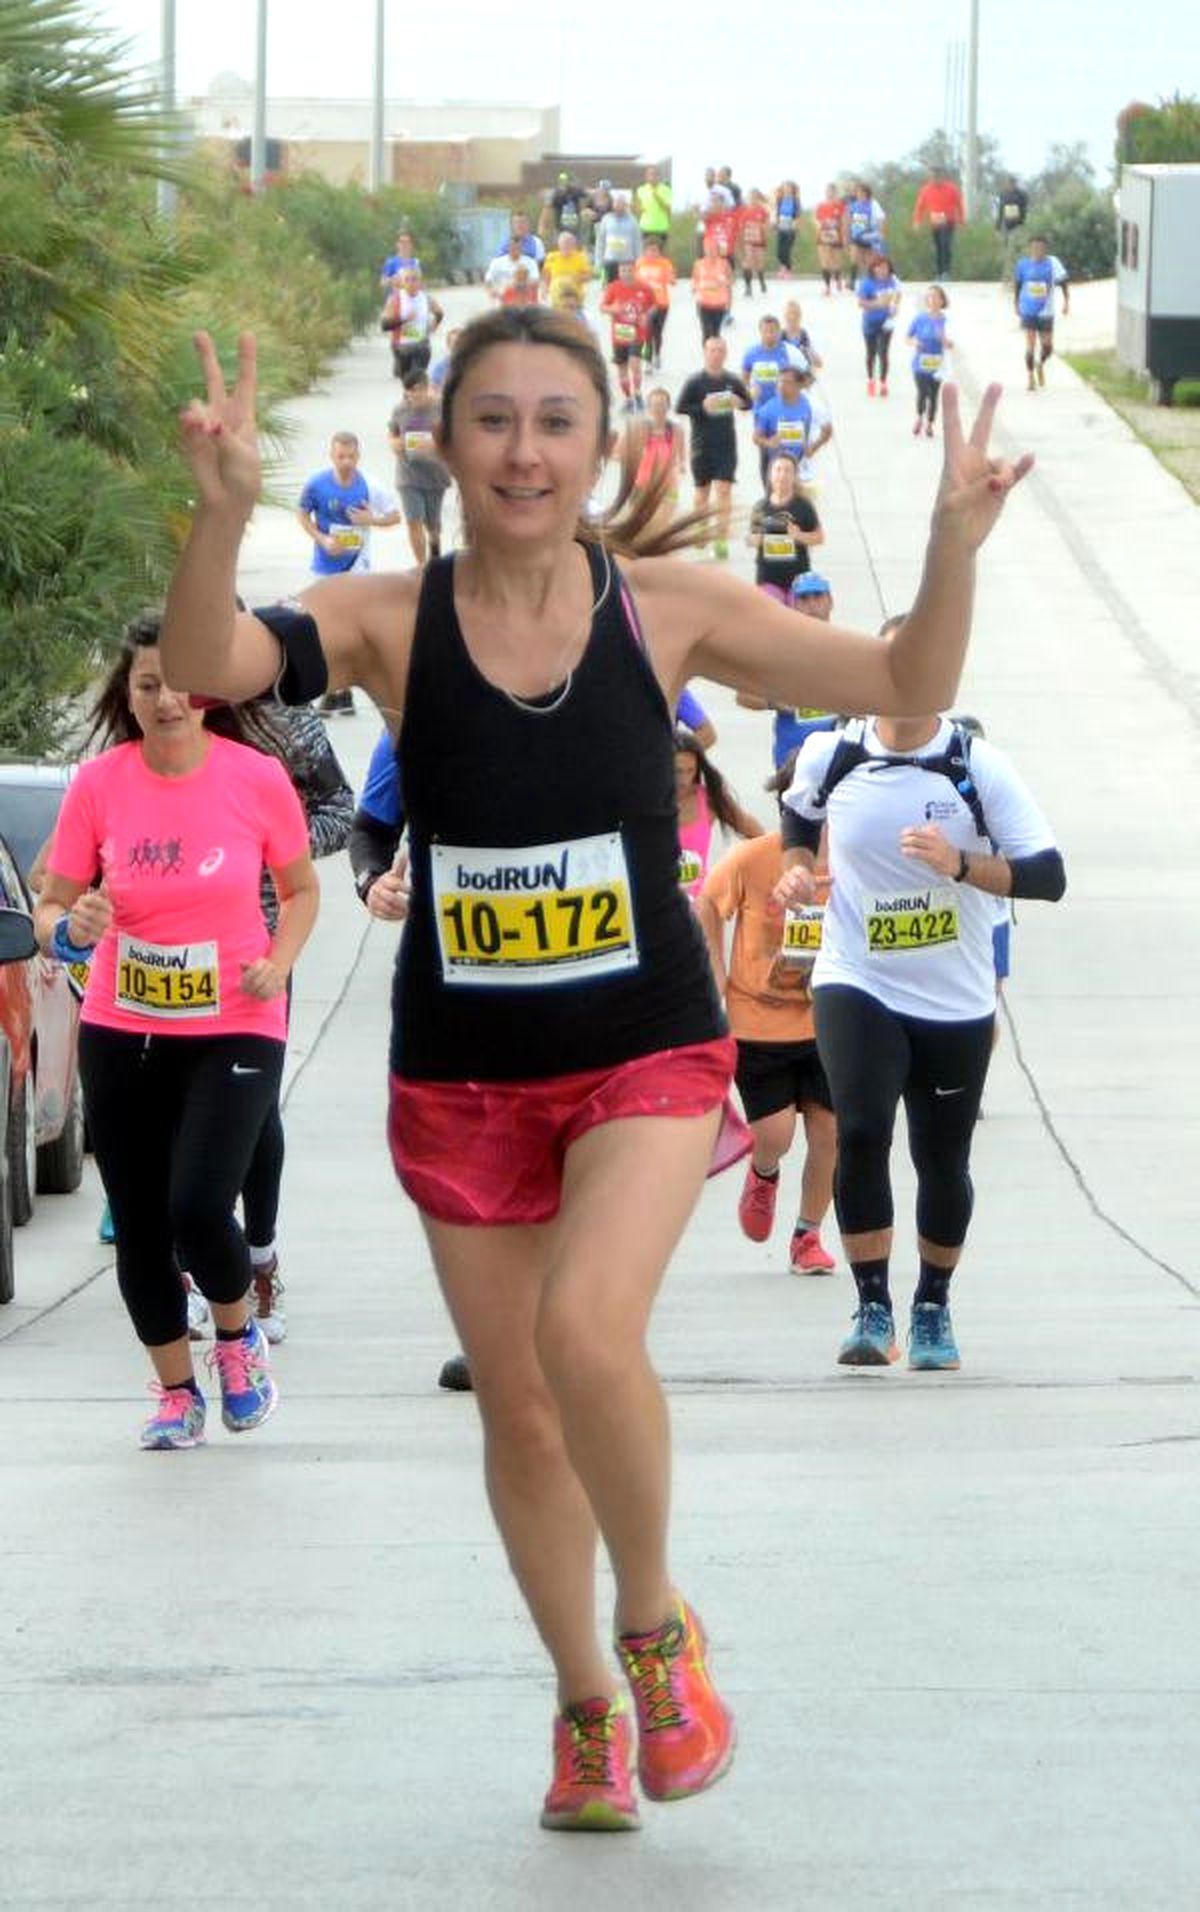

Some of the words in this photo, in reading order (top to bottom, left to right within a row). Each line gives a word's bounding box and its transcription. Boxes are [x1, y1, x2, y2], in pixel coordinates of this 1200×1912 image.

[457, 848, 569, 892] bodRUN
[875, 890, 931, 912] bodRUN
[443, 889, 622, 954] 10-172
[788, 924, 822, 945] 10-
[868, 910, 955, 945] 23-422
[127, 945, 189, 970] bodRUN
[120, 963, 214, 1001] 10-154
